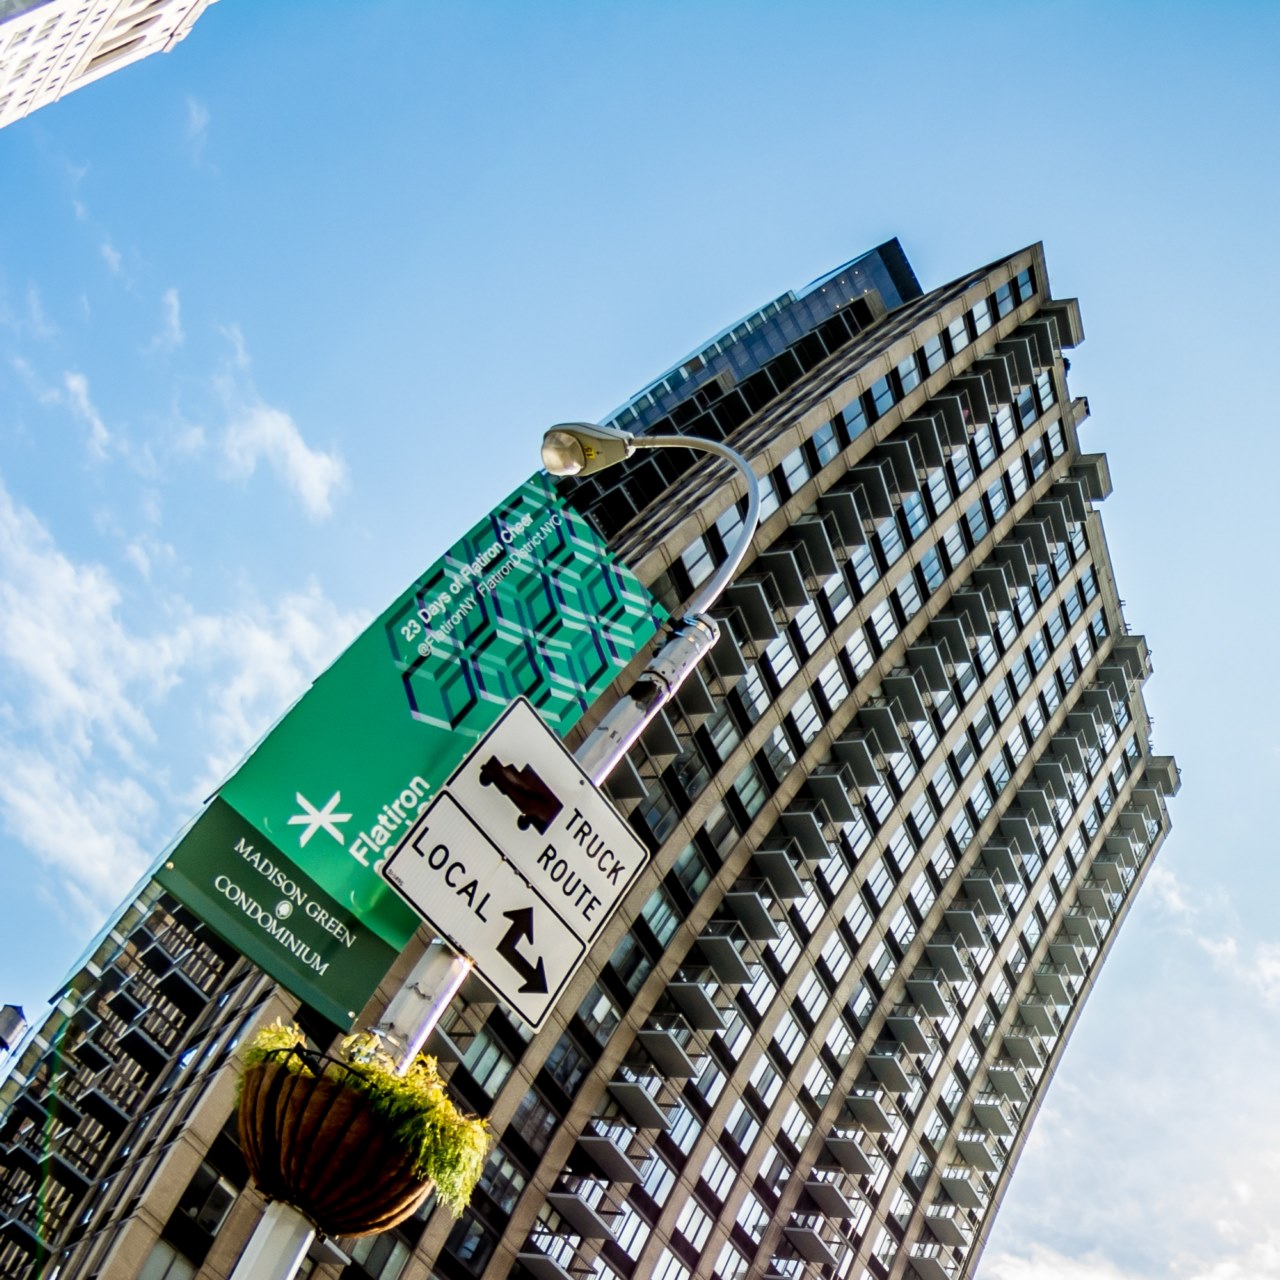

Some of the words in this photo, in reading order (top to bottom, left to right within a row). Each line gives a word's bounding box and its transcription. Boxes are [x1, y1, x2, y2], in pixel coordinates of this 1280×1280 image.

[401, 619, 421, 642] 23
[417, 589, 451, 624] Days
[450, 575, 464, 595] of
[462, 542, 502, 584] Flatiron
[500, 513, 534, 546] Cheer
[417, 593, 478, 657] @FlatironNY
[477, 514, 563, 599] FlatironDistrict.NYC
[348, 775, 431, 867] Flatiron
[566, 808, 625, 885] TRUCK
[234, 838, 308, 905] MADISON
[305, 901, 357, 948] GREEN
[411, 826, 491, 923] LOCAL
[537, 844, 601, 921] ROUTE
[214, 875, 331, 976] CONDOMINIUM
